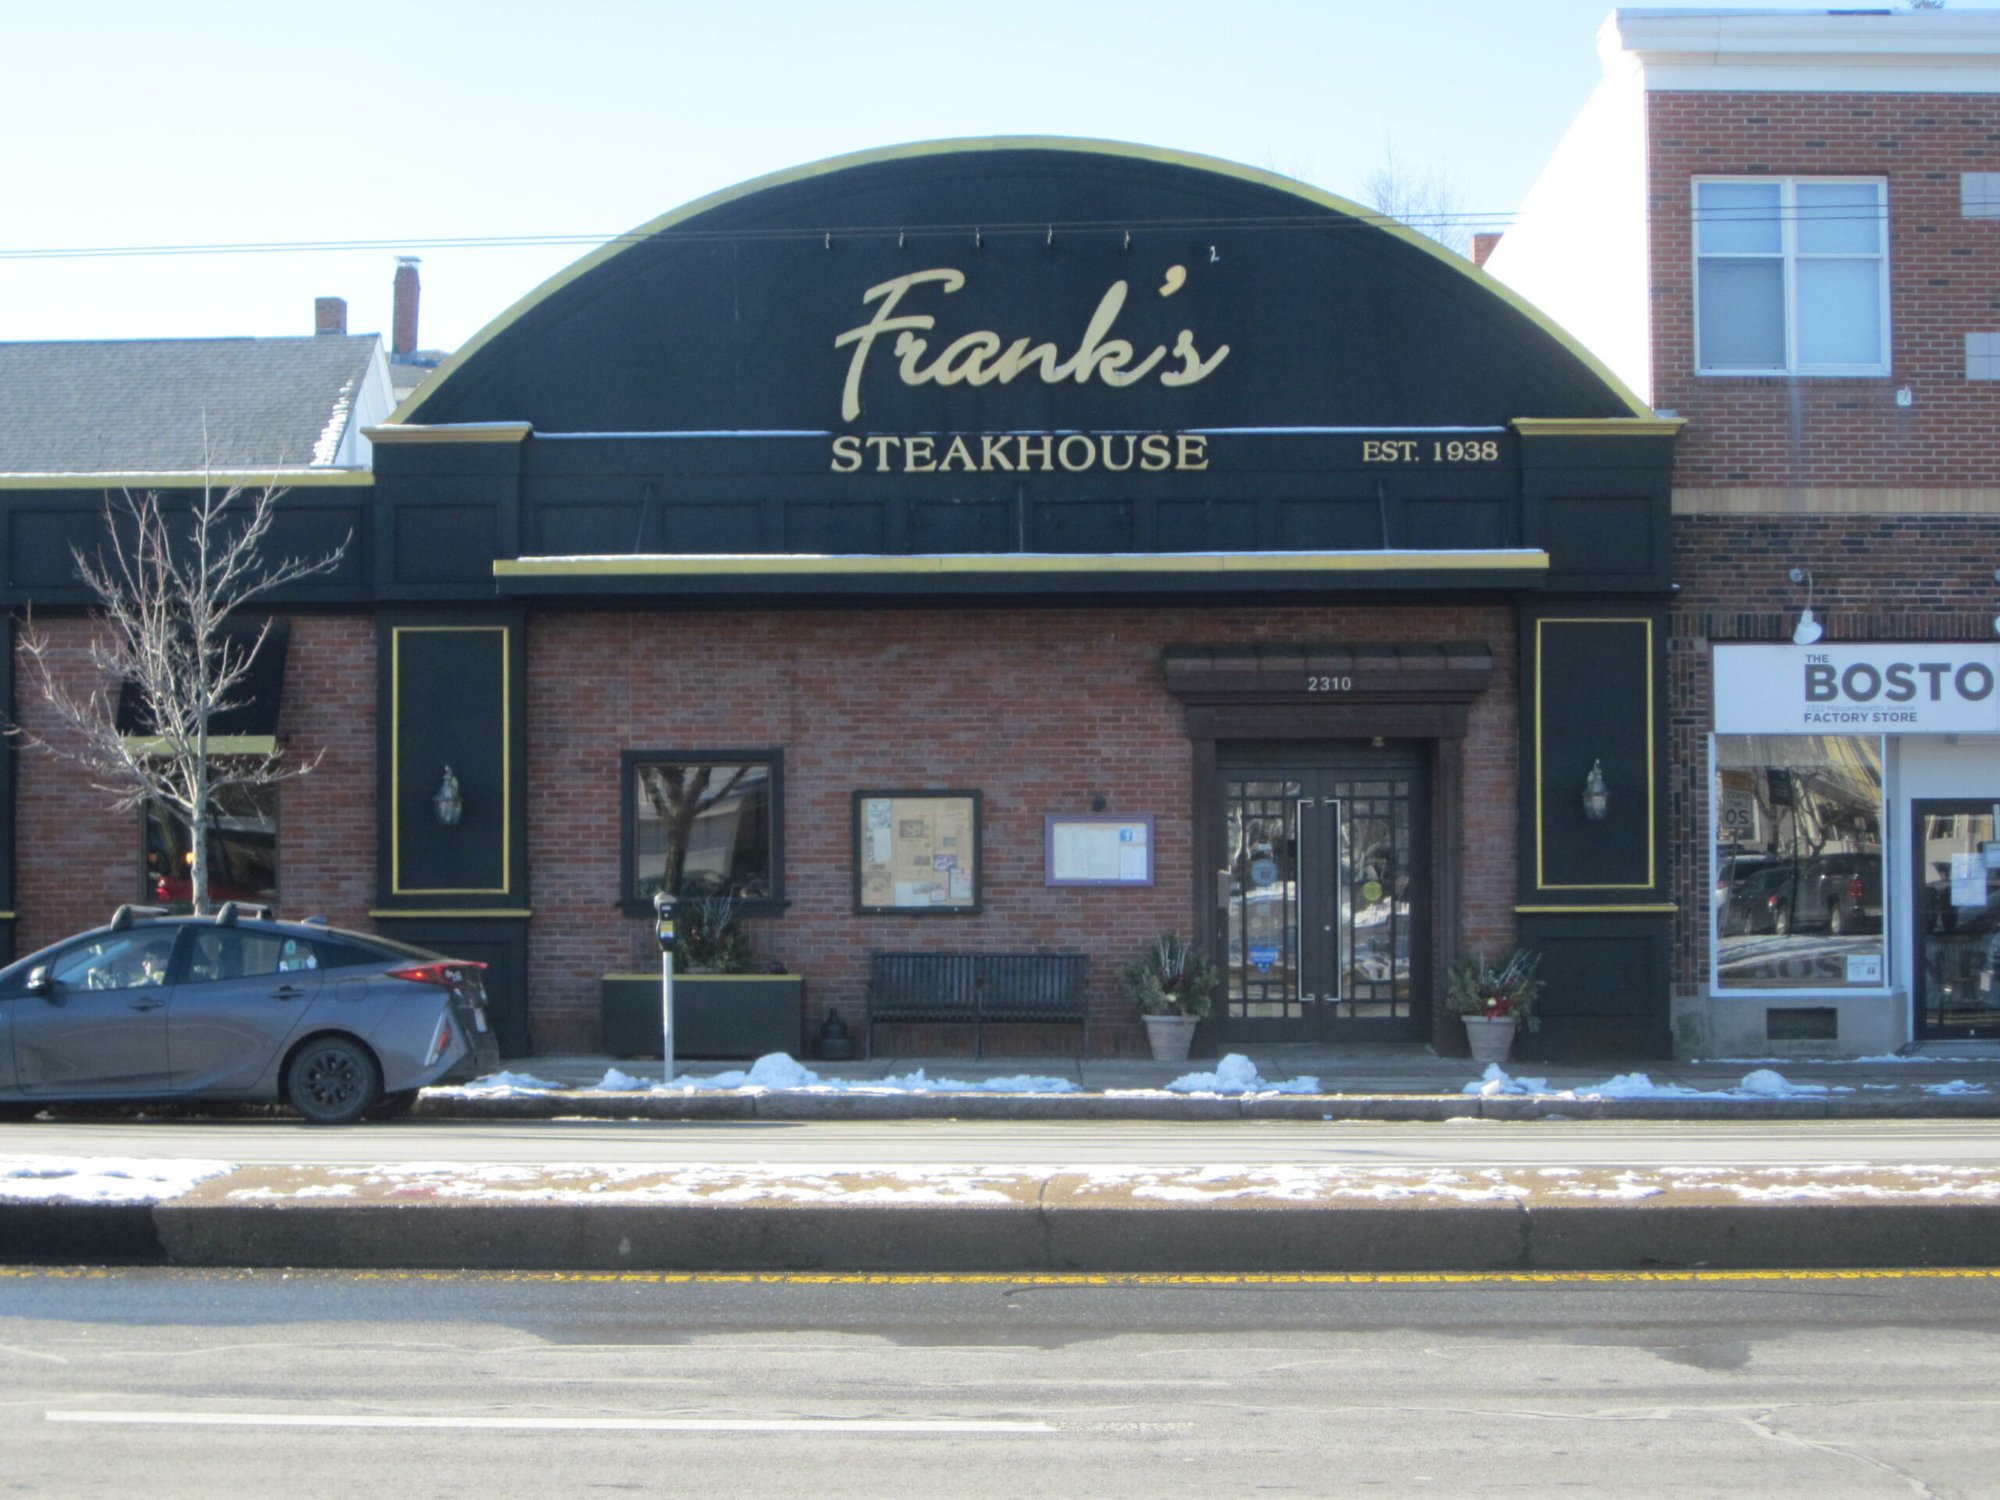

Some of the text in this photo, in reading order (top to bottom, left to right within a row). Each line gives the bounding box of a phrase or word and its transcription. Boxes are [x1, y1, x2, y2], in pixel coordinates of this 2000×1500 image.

[834, 264, 1230, 422] Frank's
[831, 435, 1209, 472] STEAKHOUSE
[1362, 440, 1498, 462] EST. 1938
[1806, 654, 1829, 663] THE
[1308, 677, 1352, 691] 2310
[1804, 662, 1994, 702] BOSTO
[1804, 713, 1917, 723] FACTORY STORE
